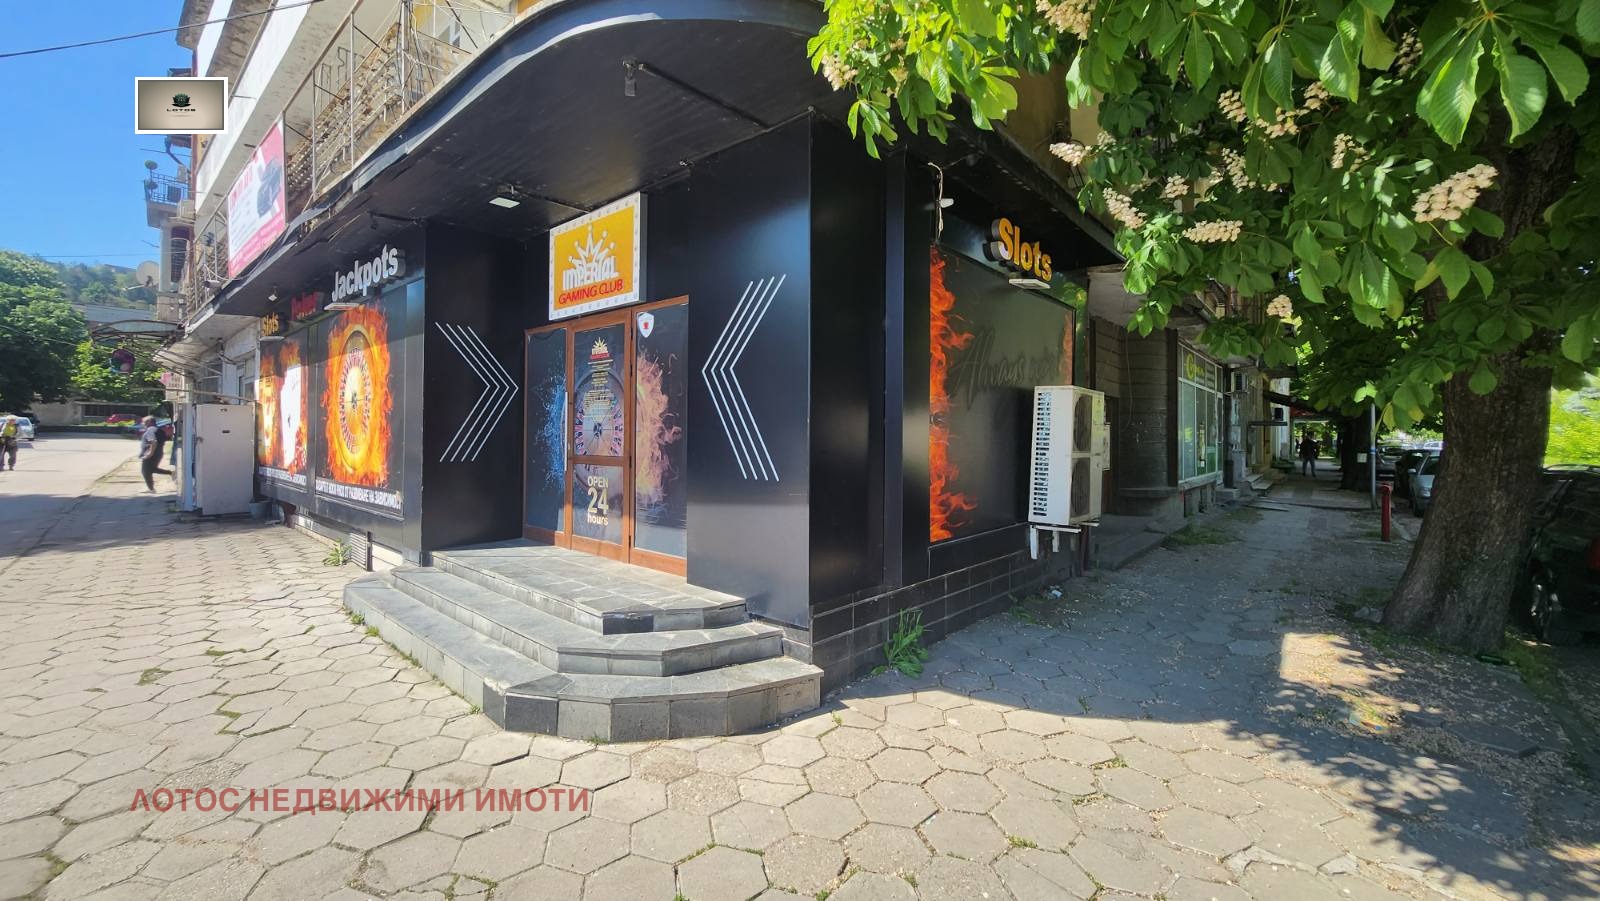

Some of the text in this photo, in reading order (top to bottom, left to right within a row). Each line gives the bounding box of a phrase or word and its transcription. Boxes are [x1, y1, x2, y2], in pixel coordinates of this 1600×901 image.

[998, 217, 1052, 281] Slots
[331, 243, 399, 302] Jackpots
[563, 256, 619, 291] IMPERIAL
[558, 278, 624, 304] GAMING CLUB
[263, 311, 279, 336] Slots
[587, 475, 609, 488] OPEN
[587, 486, 609, 515] 24
[587, 511, 609, 527] hours
